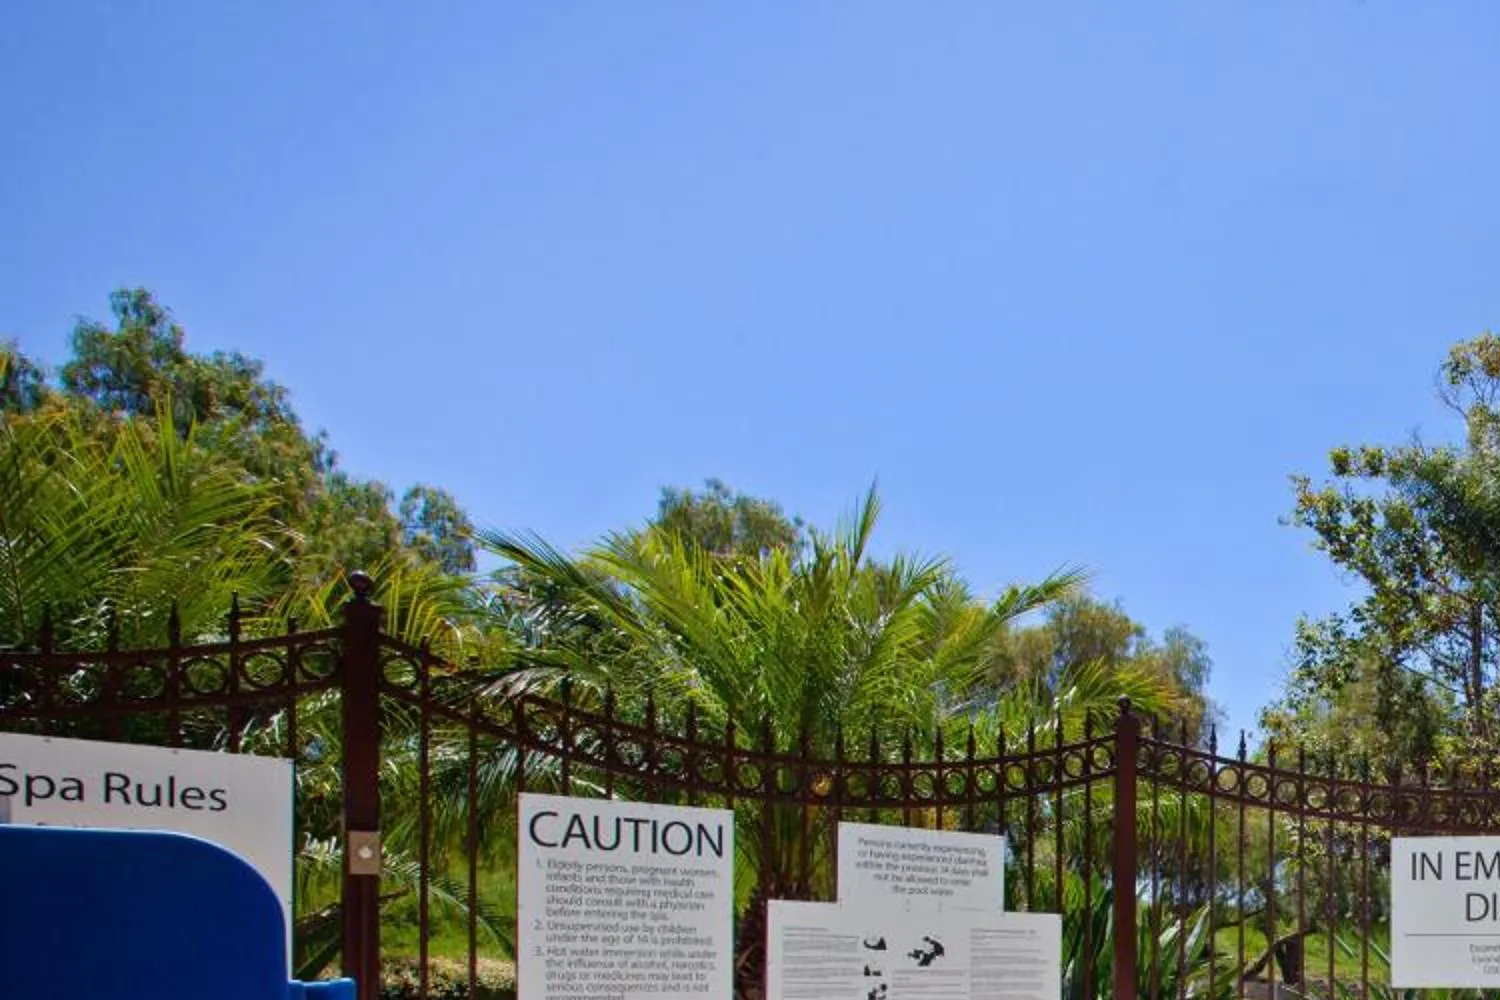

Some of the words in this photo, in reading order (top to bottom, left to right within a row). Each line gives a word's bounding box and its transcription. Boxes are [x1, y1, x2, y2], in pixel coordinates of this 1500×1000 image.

[0, 763, 84, 806] Spa
[104, 772, 227, 811] Rules
[529, 811, 723, 857] CAUTION
[1410, 851, 1442, 881] IN
